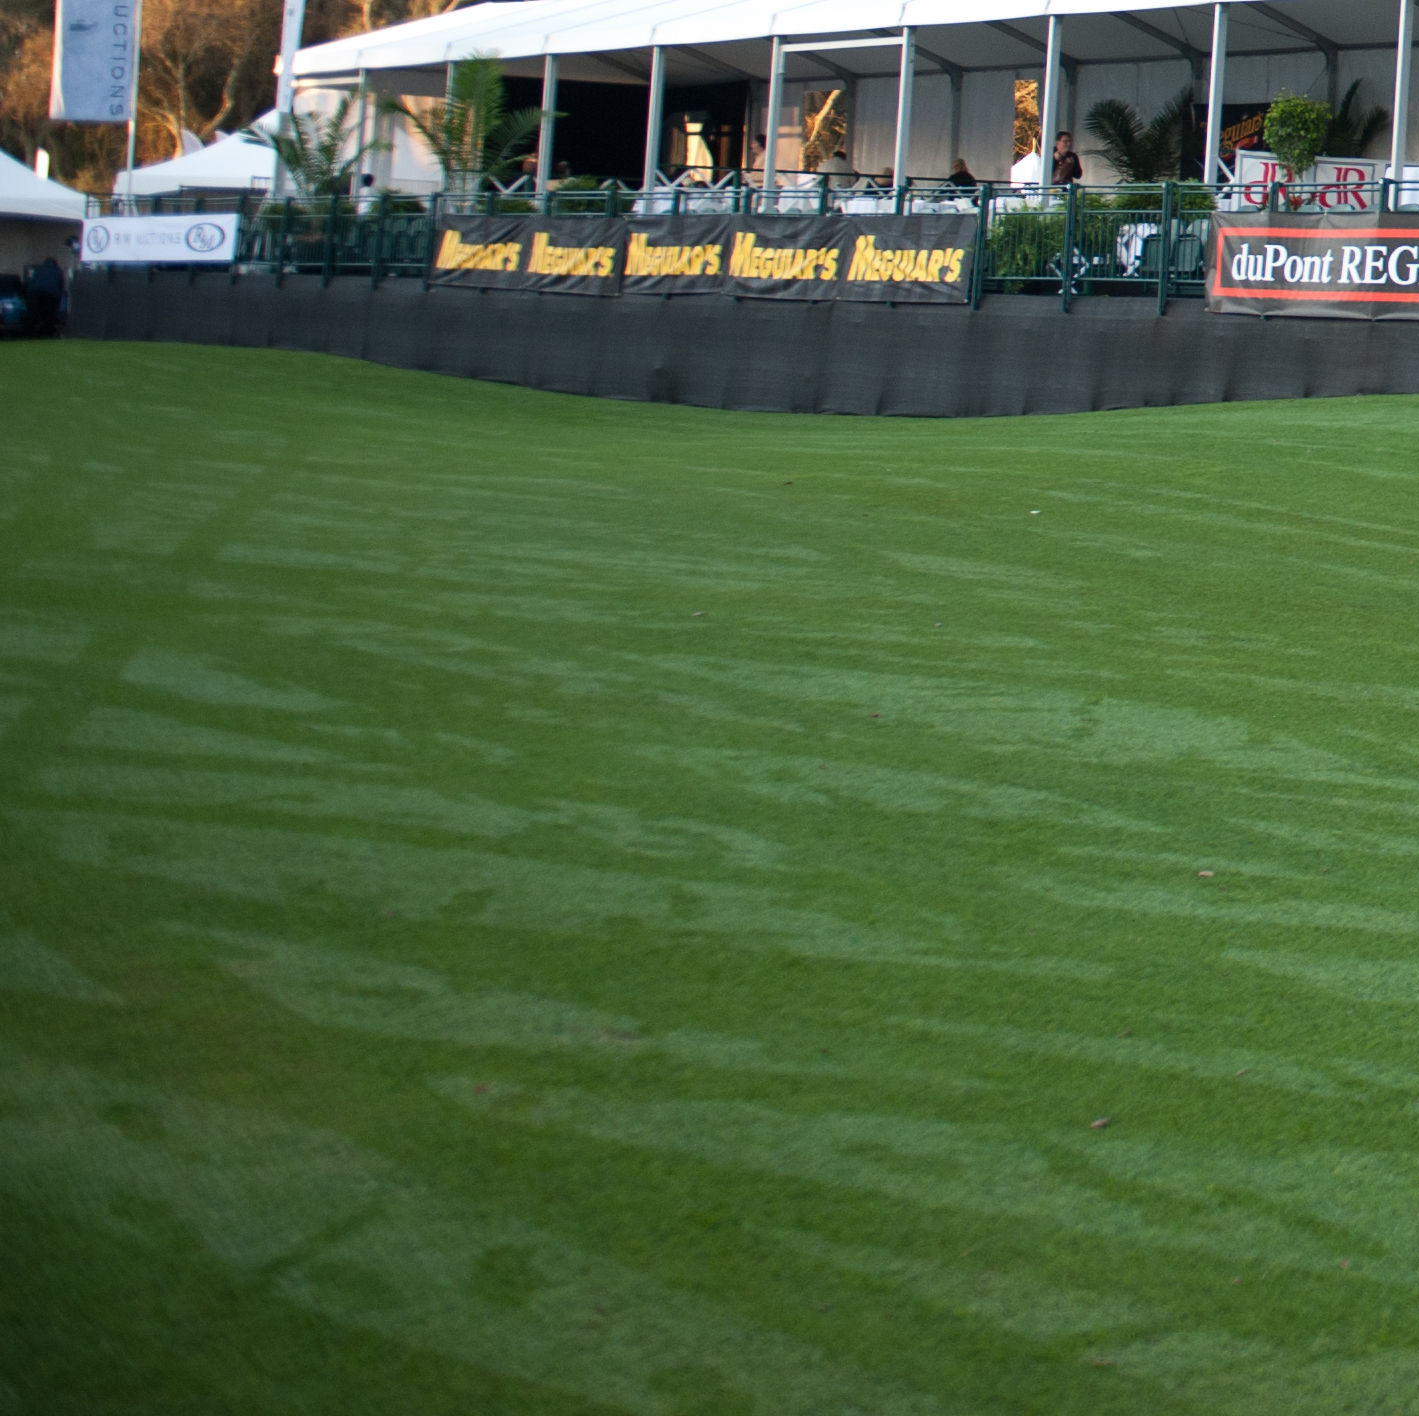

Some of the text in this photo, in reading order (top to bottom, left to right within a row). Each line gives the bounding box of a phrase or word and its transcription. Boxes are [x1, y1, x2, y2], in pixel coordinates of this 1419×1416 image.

[728, 231, 840, 280] MEGUIAR'S
[846, 234, 964, 282] MEGUIAR'S
[1231, 243, 1332, 283] duPont
